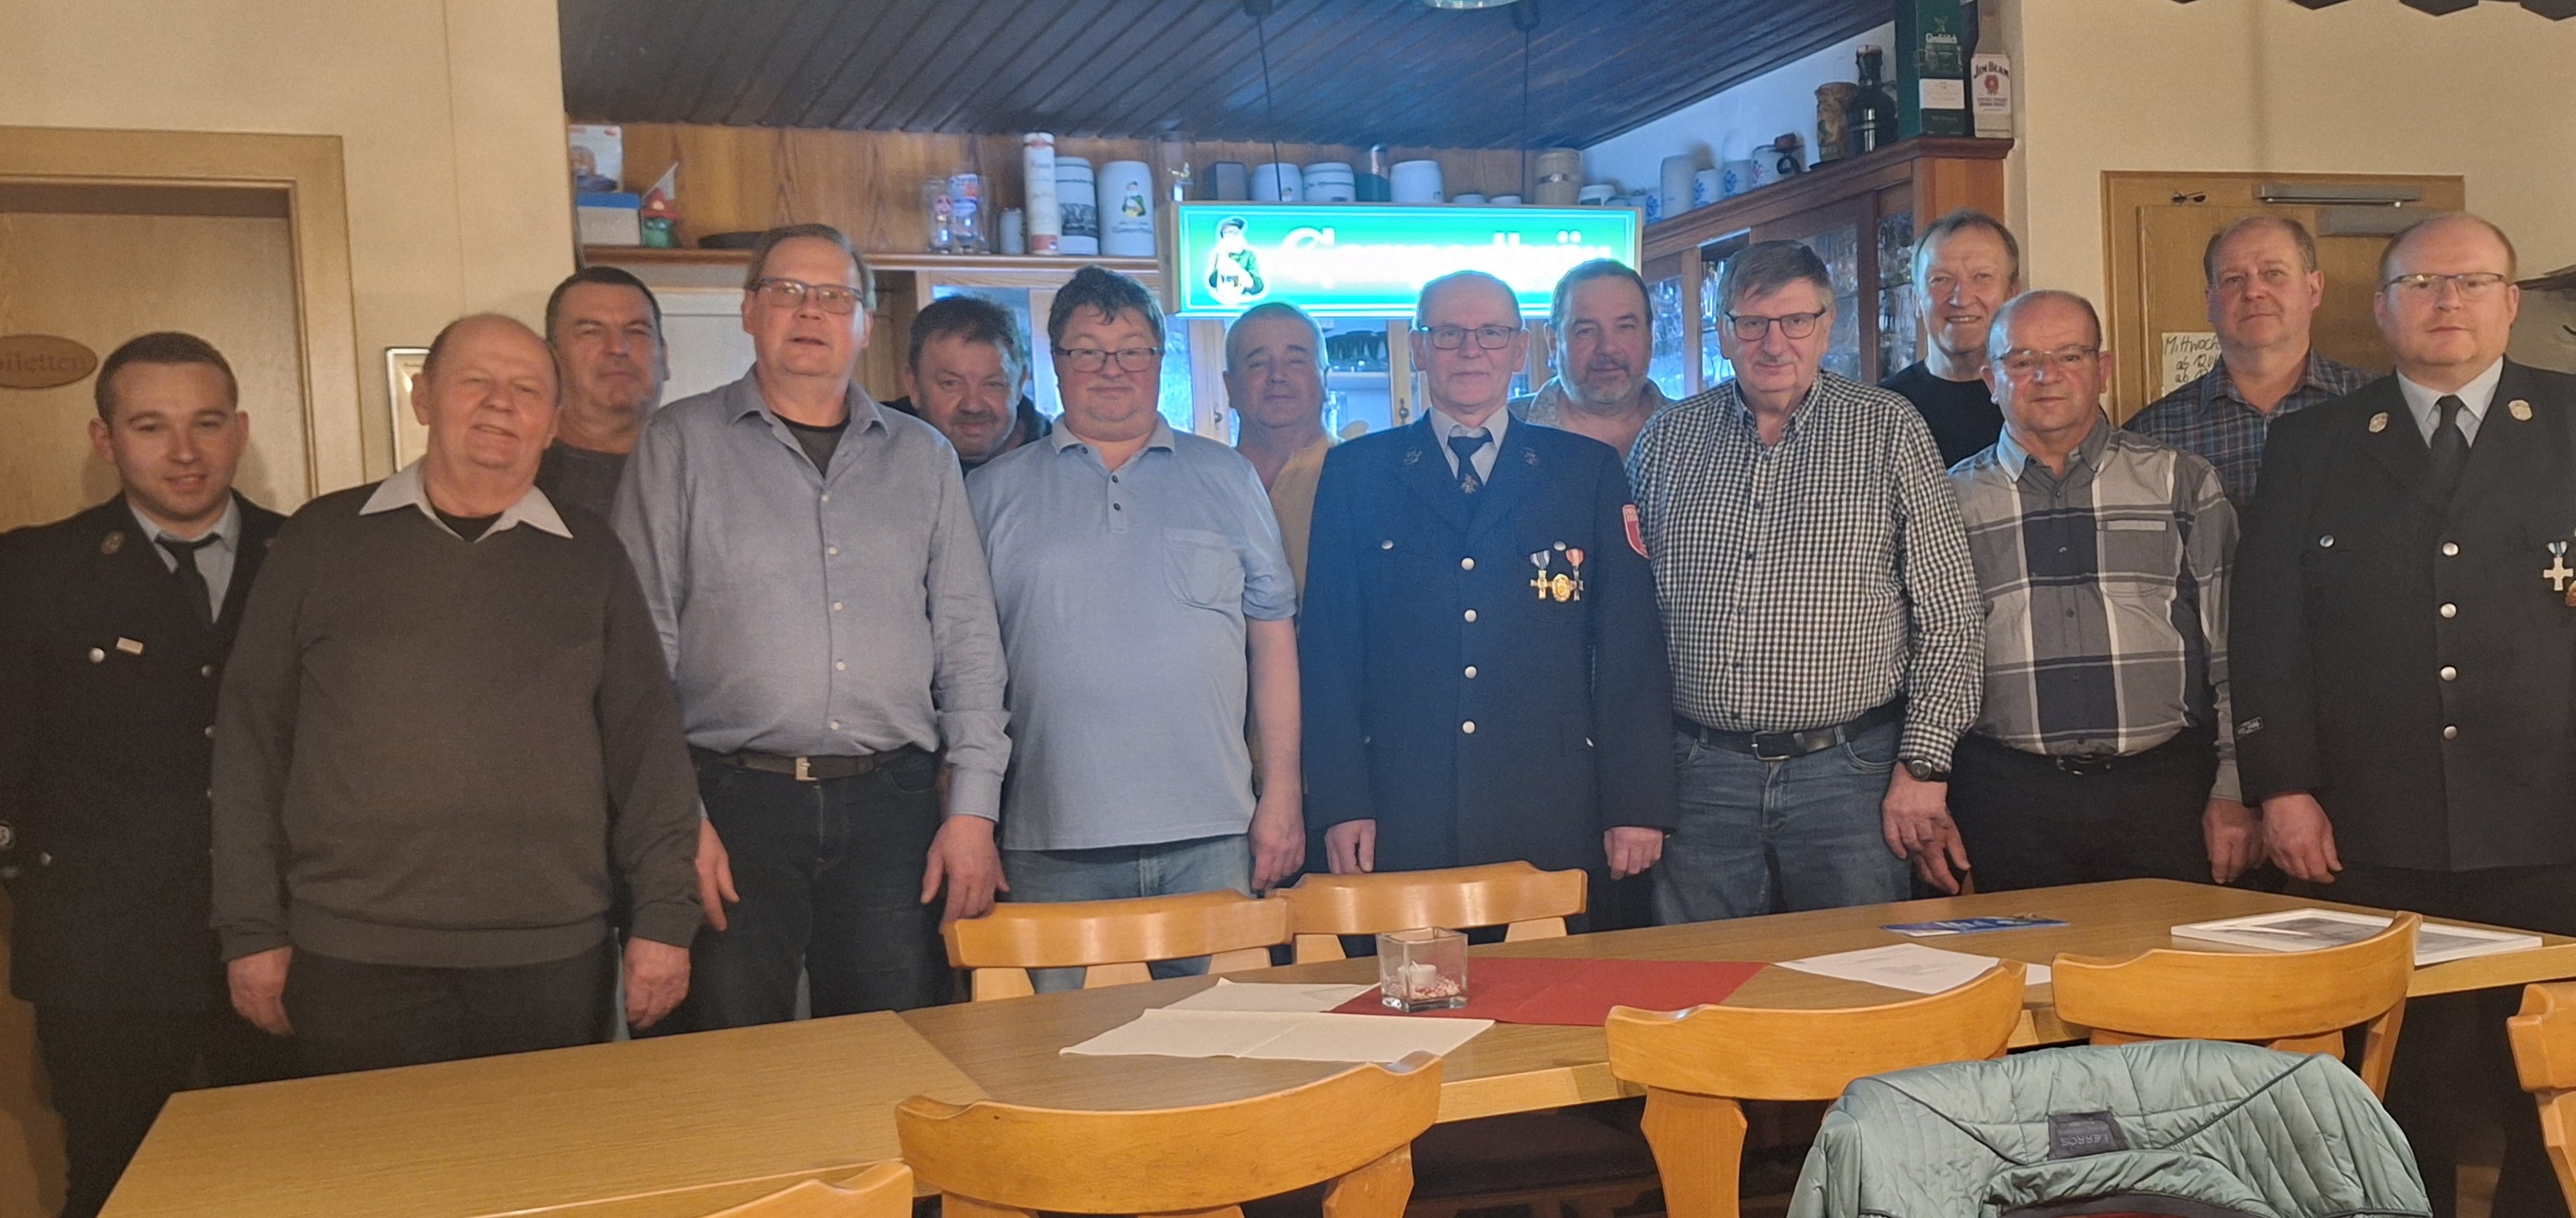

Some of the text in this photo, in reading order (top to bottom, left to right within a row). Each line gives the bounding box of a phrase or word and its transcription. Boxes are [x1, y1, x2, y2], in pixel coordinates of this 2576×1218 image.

[1973, 61, 2009, 79] JIM BEAM
[2060, 1134, 2108, 1146] LERROS
